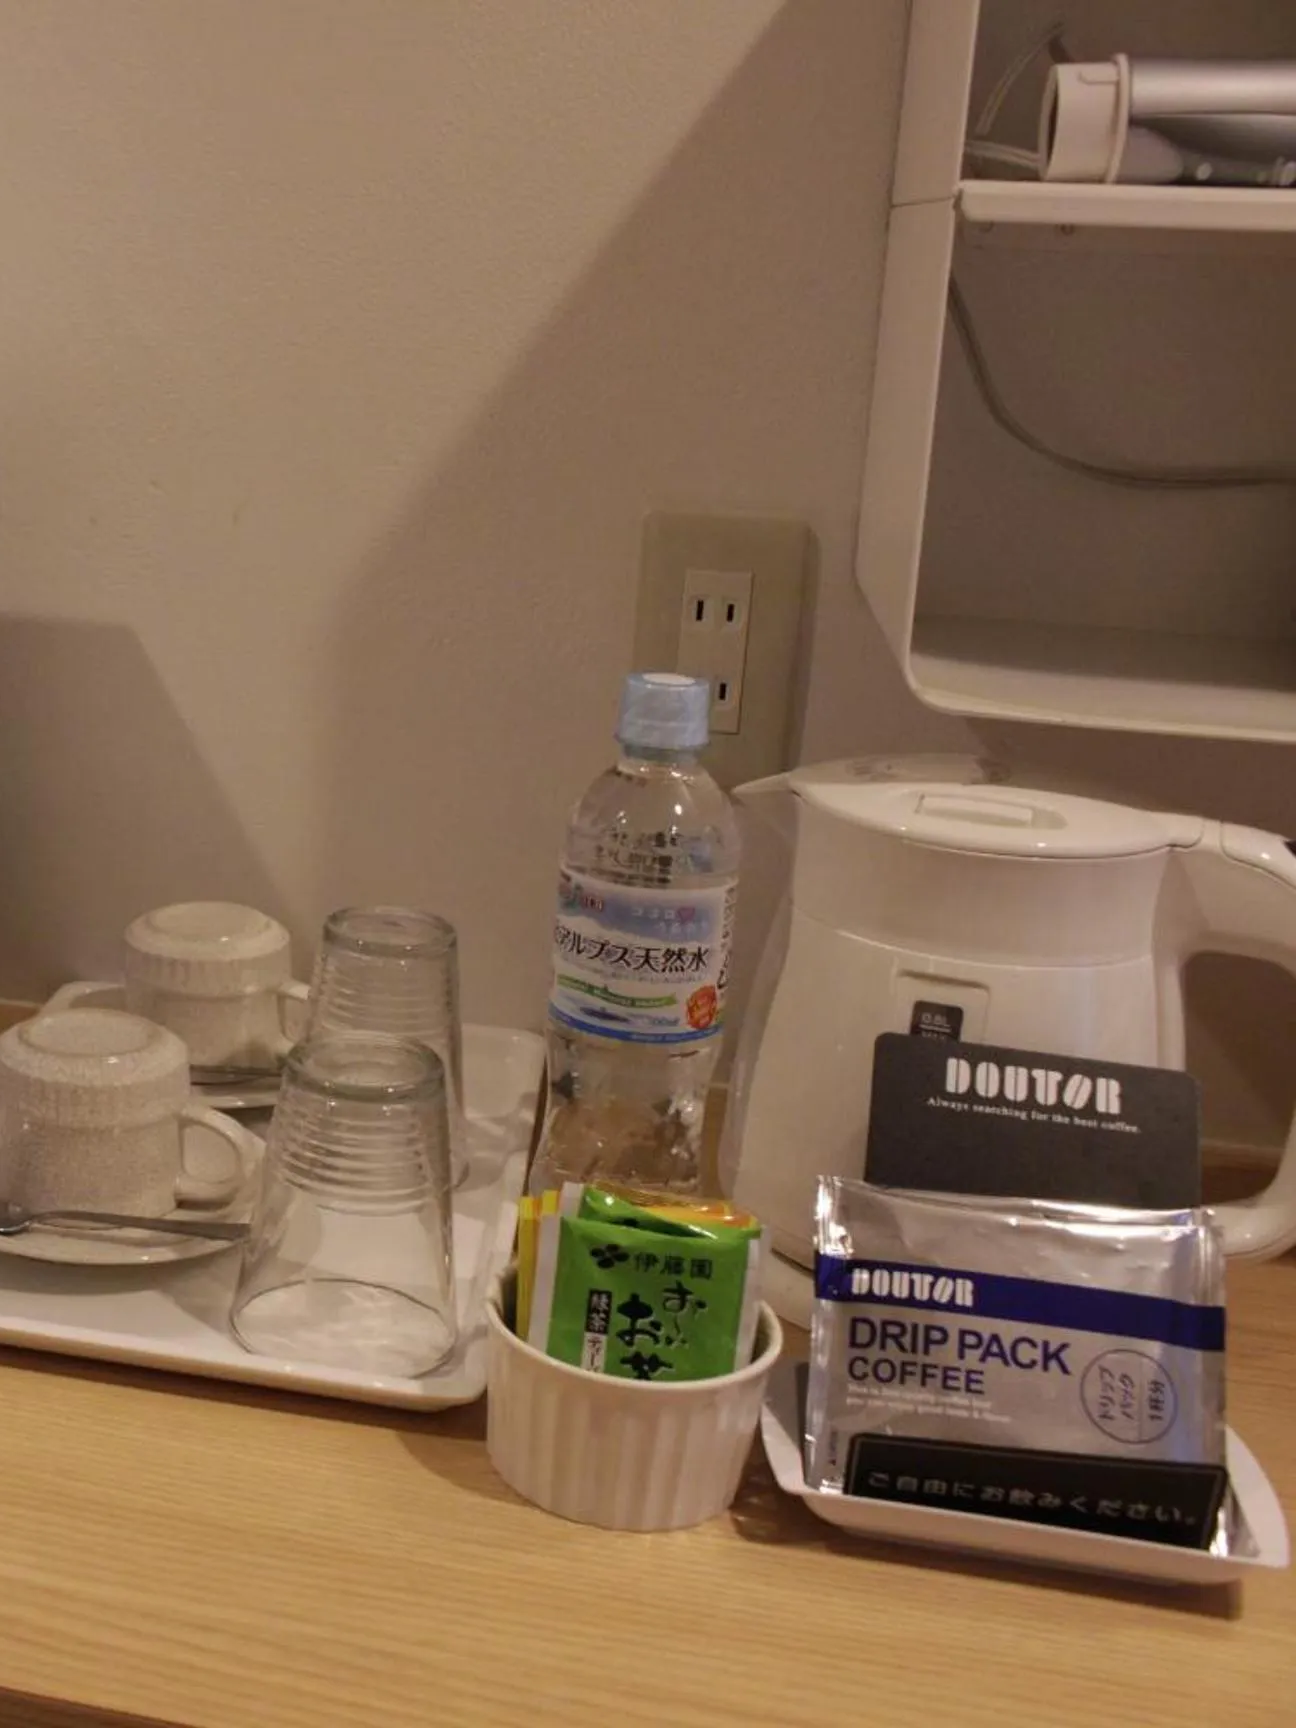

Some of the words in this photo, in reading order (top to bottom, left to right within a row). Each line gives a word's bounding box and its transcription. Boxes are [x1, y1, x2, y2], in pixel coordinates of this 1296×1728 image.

[555, 924, 710, 974] アルプス天然水
[945, 1056, 1122, 1116] DOUTOR
[927, 1096, 969, 1112] Always
[972, 1104, 1029, 1121] searching
[1030, 1110, 1049, 1122] for
[1051, 1114, 1070, 1125] the
[1073, 1116, 1098, 1128] best
[633, 1251, 713, 1280] 伊藤園
[851, 1267, 975, 1308] DOUTOR
[849, 1315, 950, 1357] DRIP
[957, 1327, 1073, 1377] PACK
[848, 1355, 986, 1396] COFFEE
[867, 1471, 1196, 1526] ご自由にお飲みください。
